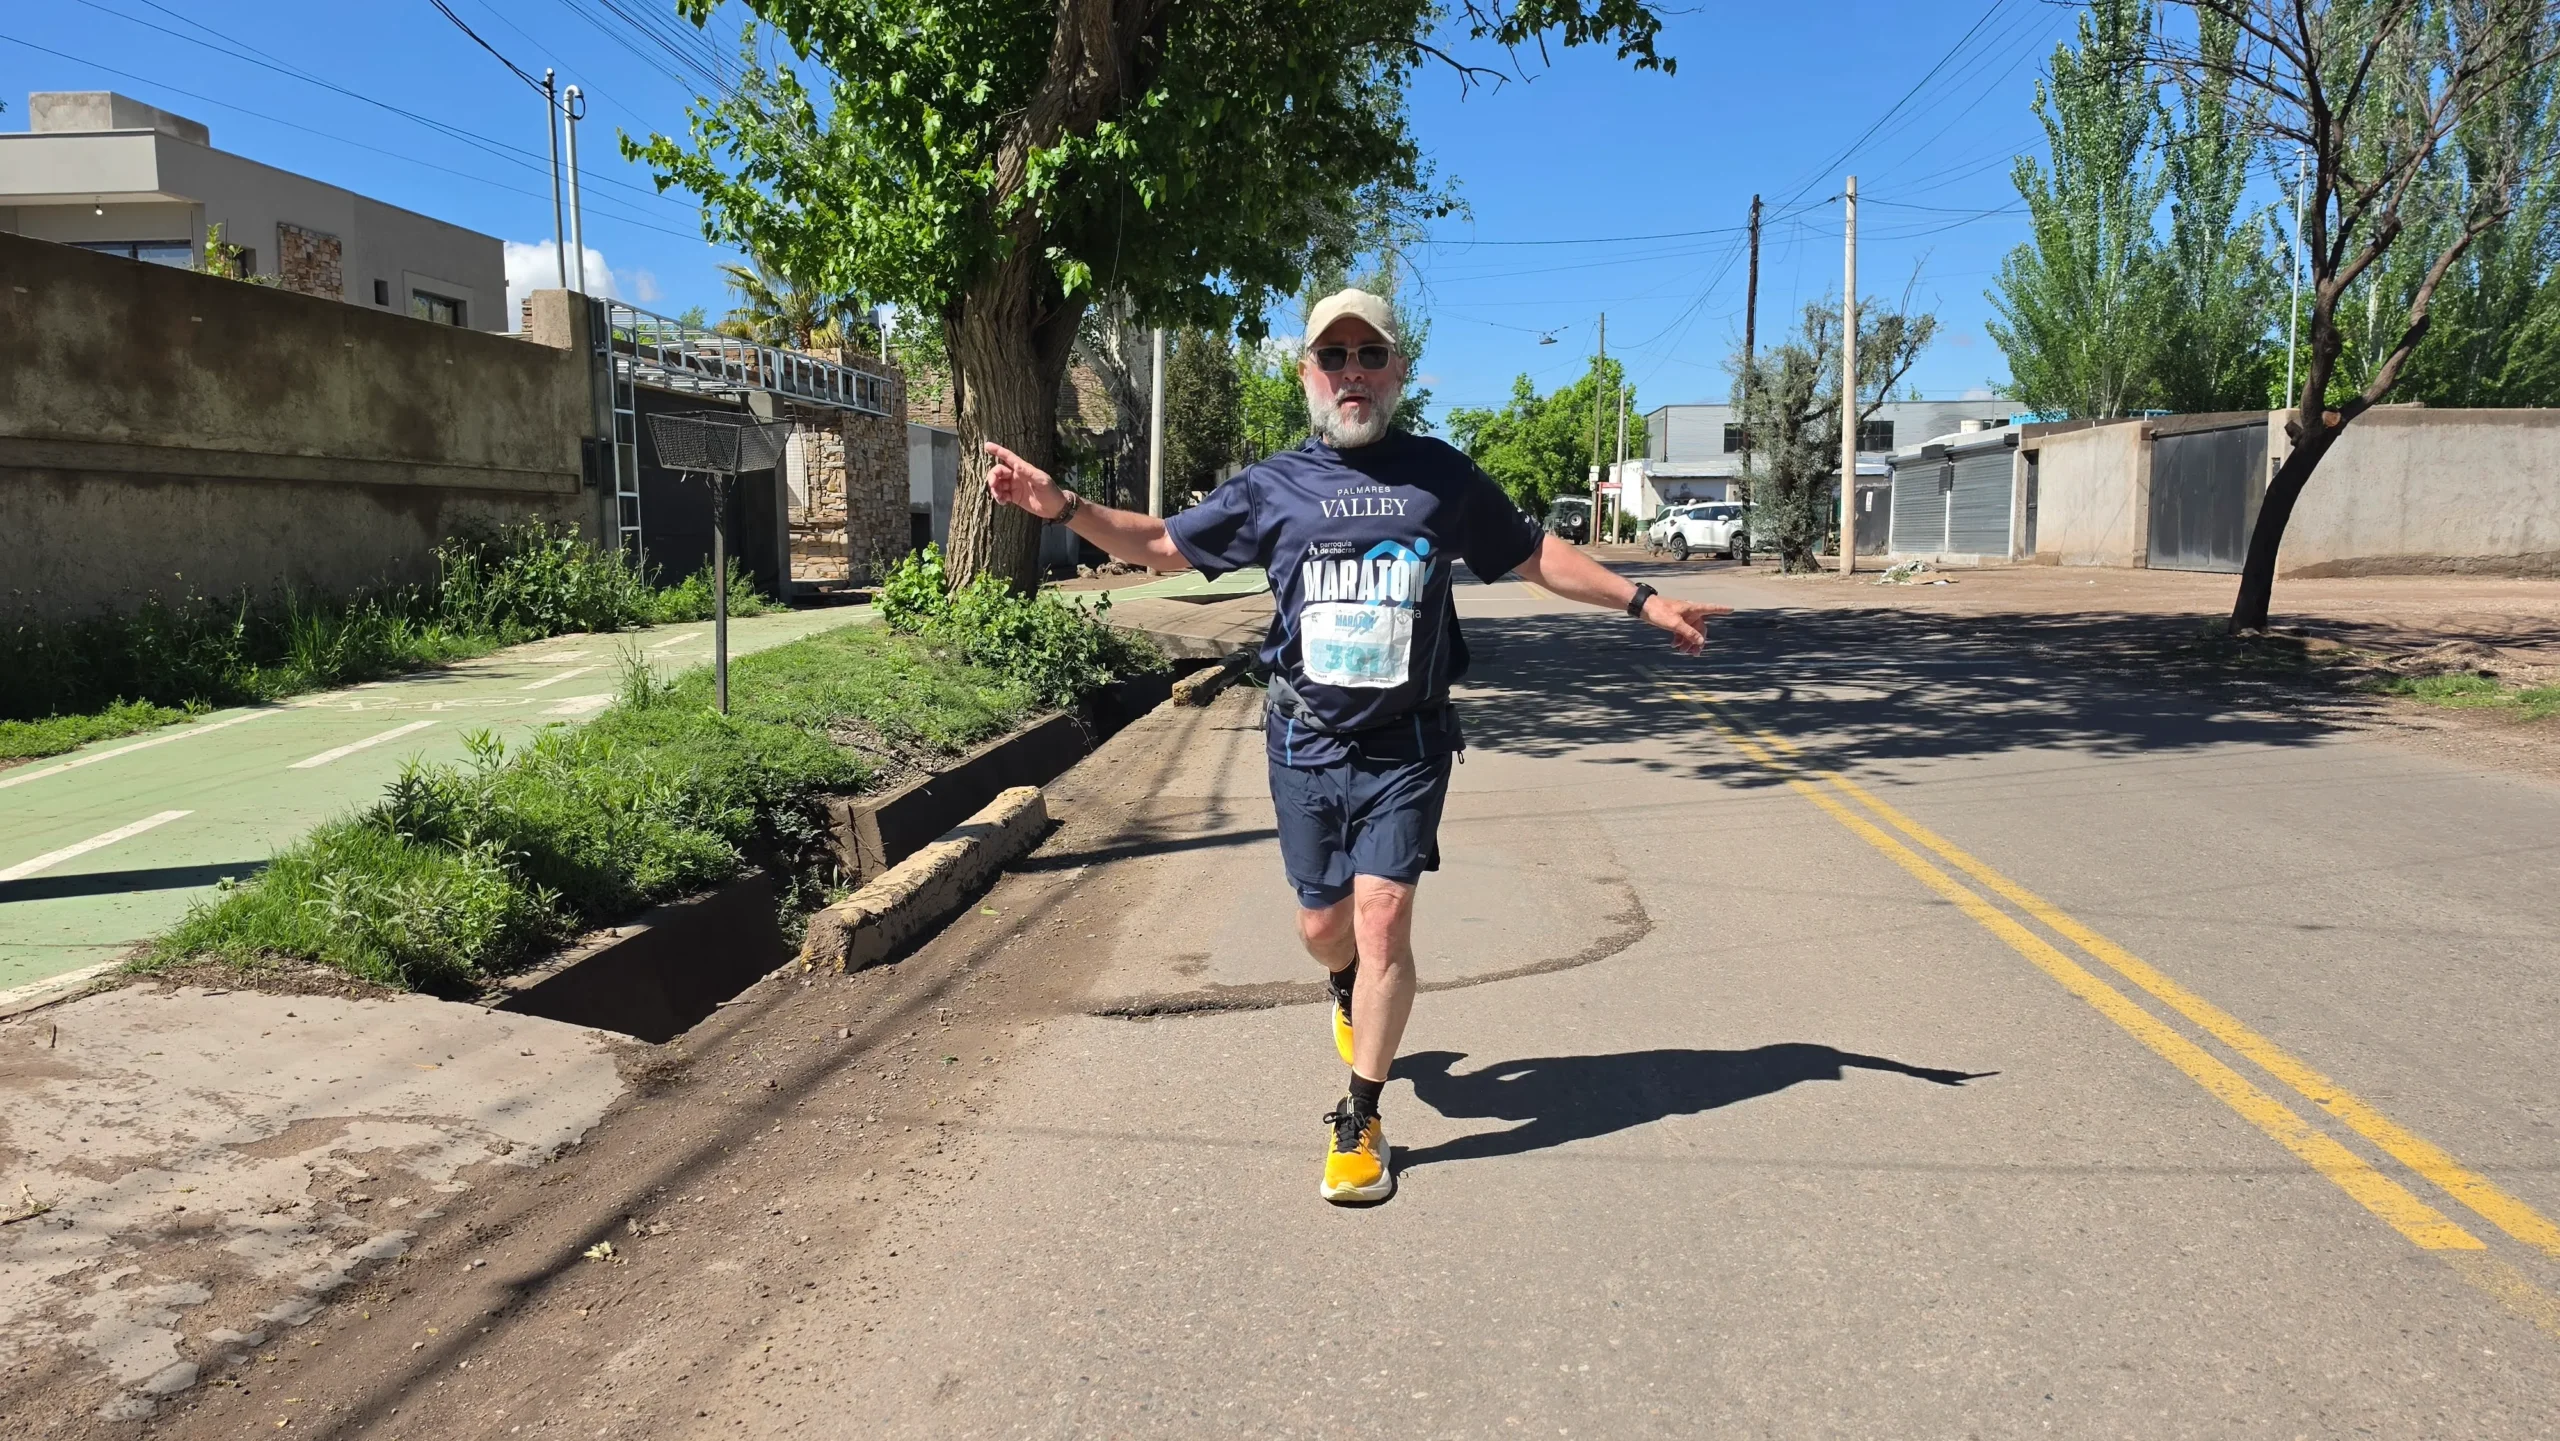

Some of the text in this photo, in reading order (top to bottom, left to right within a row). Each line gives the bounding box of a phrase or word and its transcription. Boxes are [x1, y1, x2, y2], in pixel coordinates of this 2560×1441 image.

[1337, 486, 1391, 497] PALMARES
[1320, 498, 1408, 518] VALLEY
[1320, 540, 1352, 549] parroquia
[1302, 550, 1426, 602] MARATÓN
